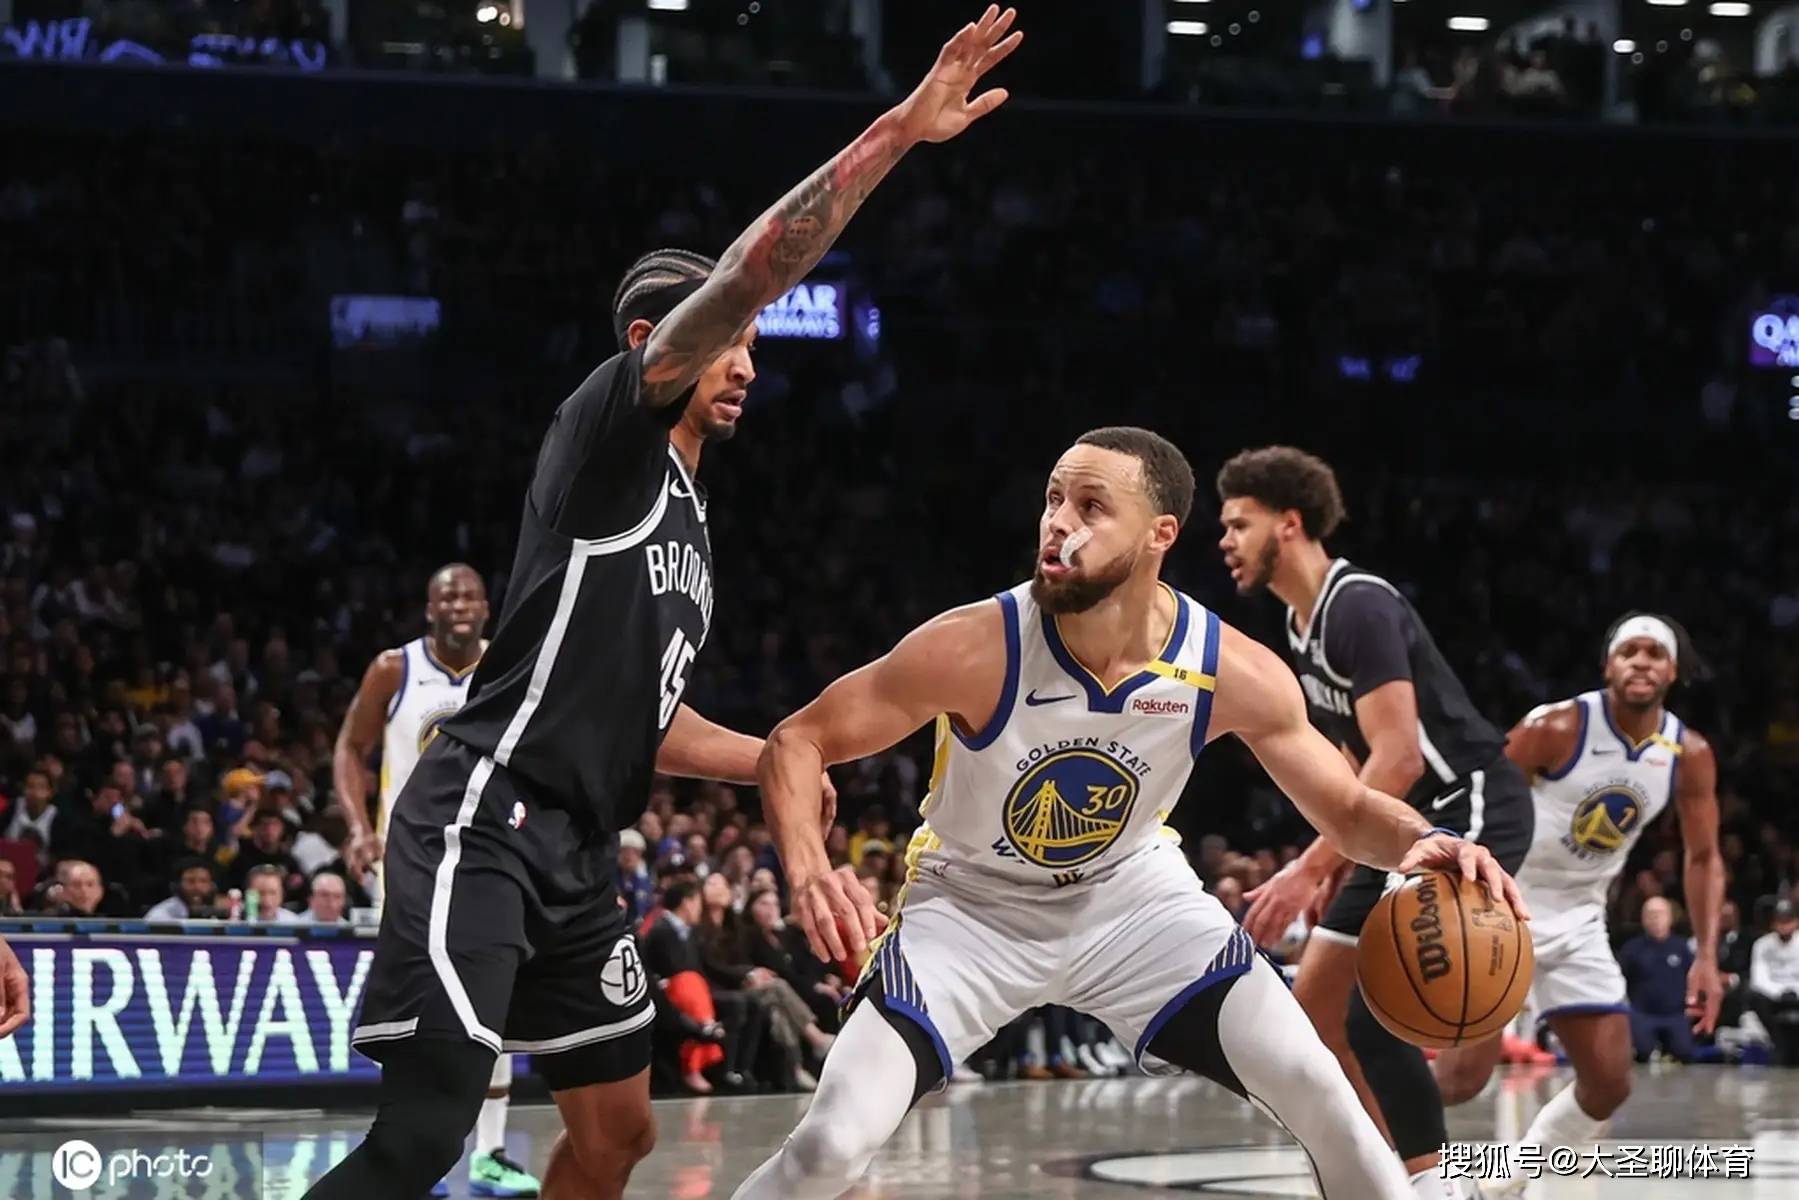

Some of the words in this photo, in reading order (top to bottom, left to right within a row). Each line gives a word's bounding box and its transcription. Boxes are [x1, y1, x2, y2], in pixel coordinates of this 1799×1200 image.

[764, 284, 838, 316] TAR
[646, 541, 714, 652] BROOK
[1174, 668, 1188, 680] 16
[1132, 699, 1189, 714] Rakuten
[1016, 737, 1099, 772] GOLDEN
[1107, 741, 1152, 777] STATE
[1081, 785, 1127, 815] 30
[1410, 877, 1452, 985] Wilson
[0, 948, 375, 1081] IRWAY
